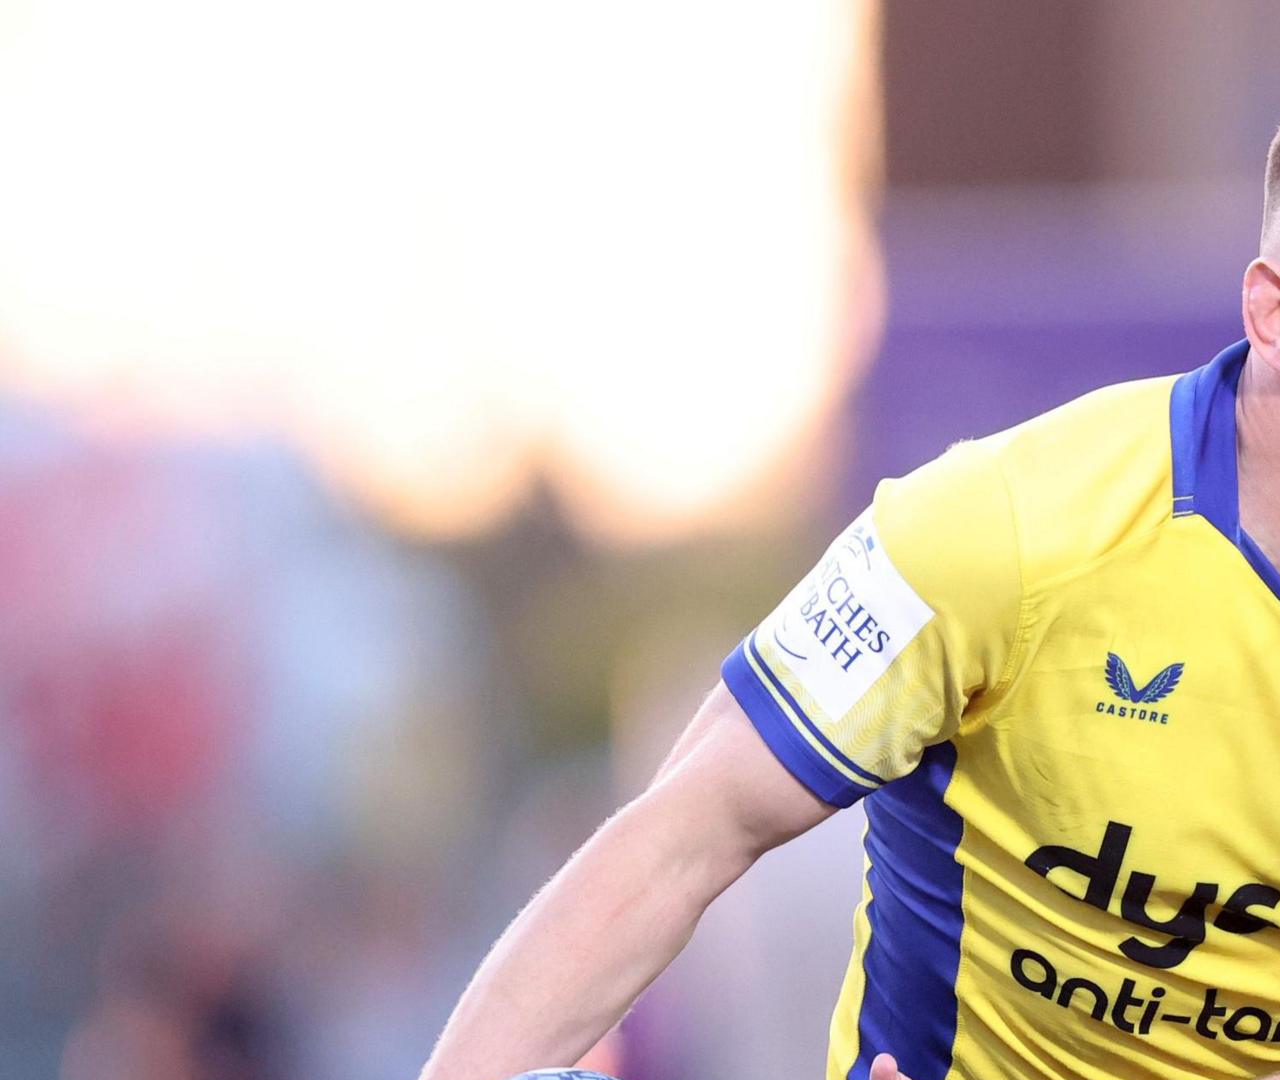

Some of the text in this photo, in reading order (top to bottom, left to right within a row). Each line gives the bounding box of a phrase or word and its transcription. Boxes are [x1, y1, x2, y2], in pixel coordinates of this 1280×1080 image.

[800, 591, 863, 673] BATH
[820, 554, 890, 654] ATCHES
[1096, 701, 1170, 725] CASTORE
